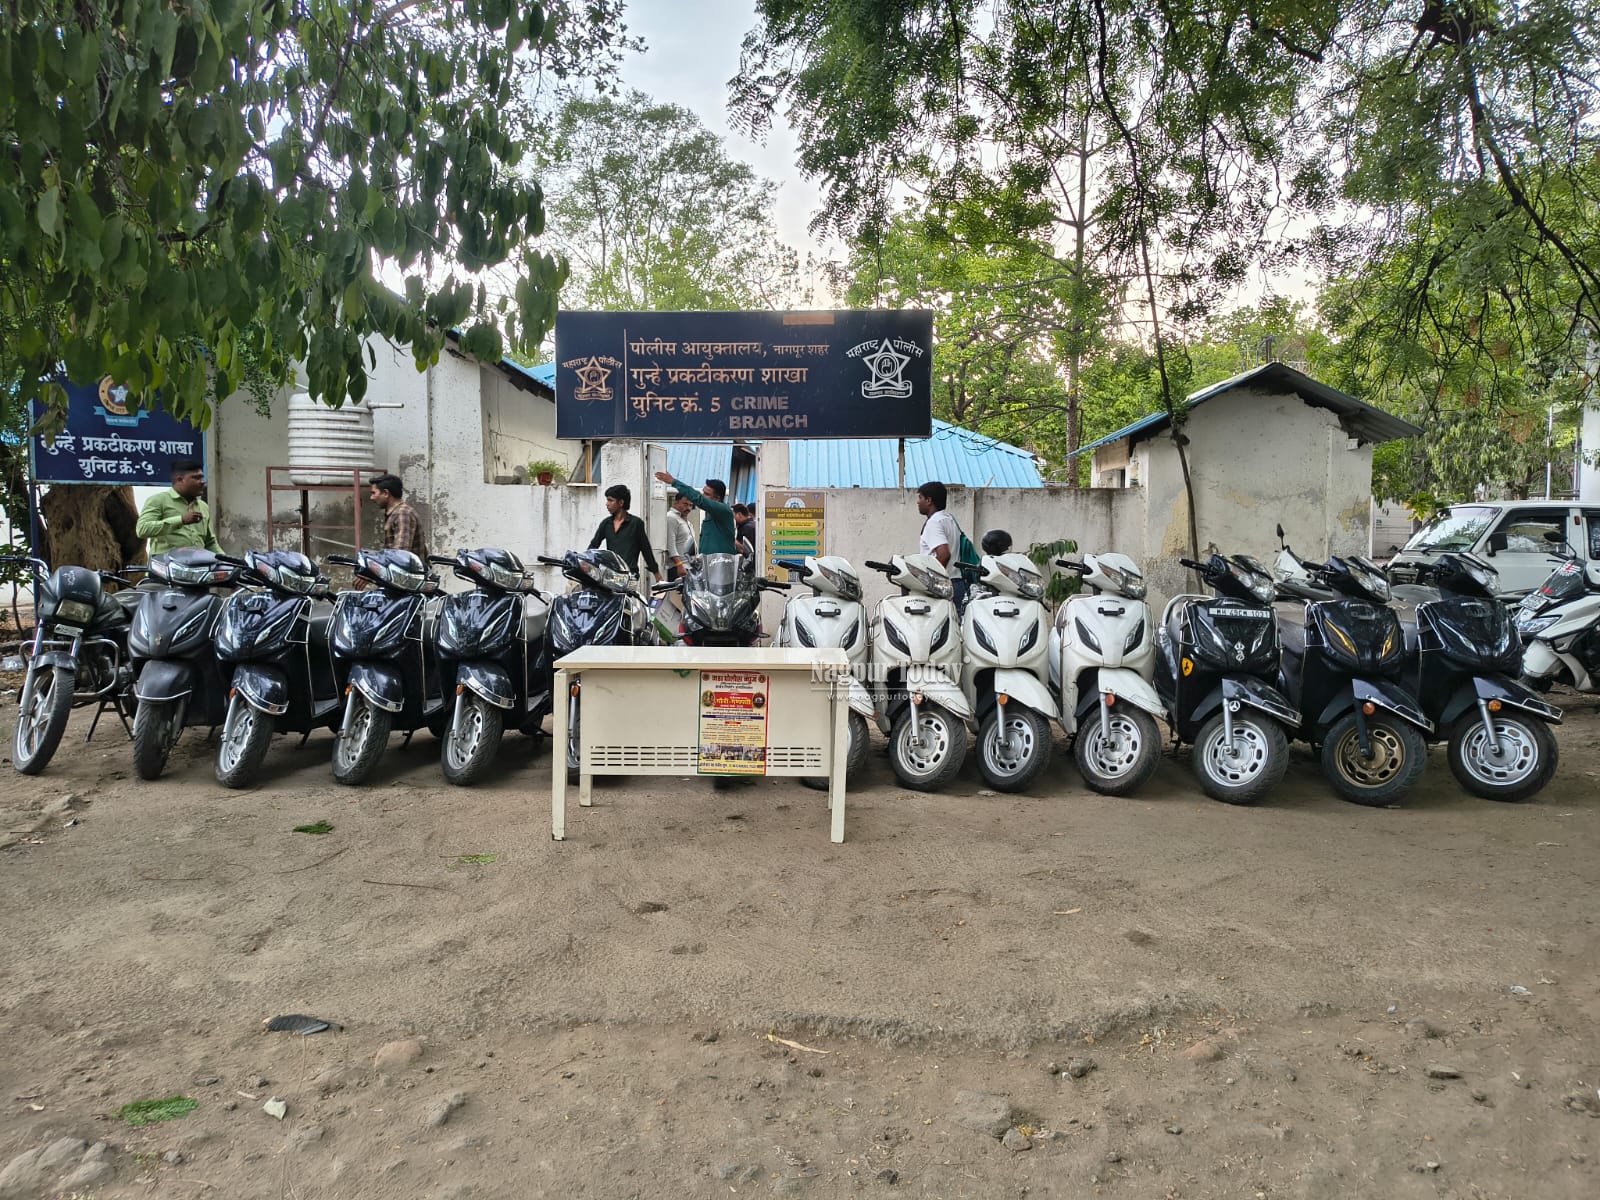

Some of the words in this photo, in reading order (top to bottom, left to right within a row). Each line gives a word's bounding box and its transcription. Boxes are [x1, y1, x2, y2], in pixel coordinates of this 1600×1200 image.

[629, 337, 677, 356] पोलीस
[682, 342, 767, 360] आयुक्तालय,
[773, 345, 805, 358] नागपूर
[807, 345, 830, 356] शहर
[630, 361, 663, 389] गुन्हे
[666, 362, 755, 384] प्रकटीकरण
[760, 368, 808, 384] शाखा
[630, 391, 677, 418] युनिट
[710, 397, 720, 412] 5
[731, 396, 789, 410] CRIME
[729, 414, 808, 429] BRANCH
[82, 433, 156, 456] प्रकटीकरण
[160, 440, 194, 455] शाखा
[78, 456, 118, 478] युनिट
